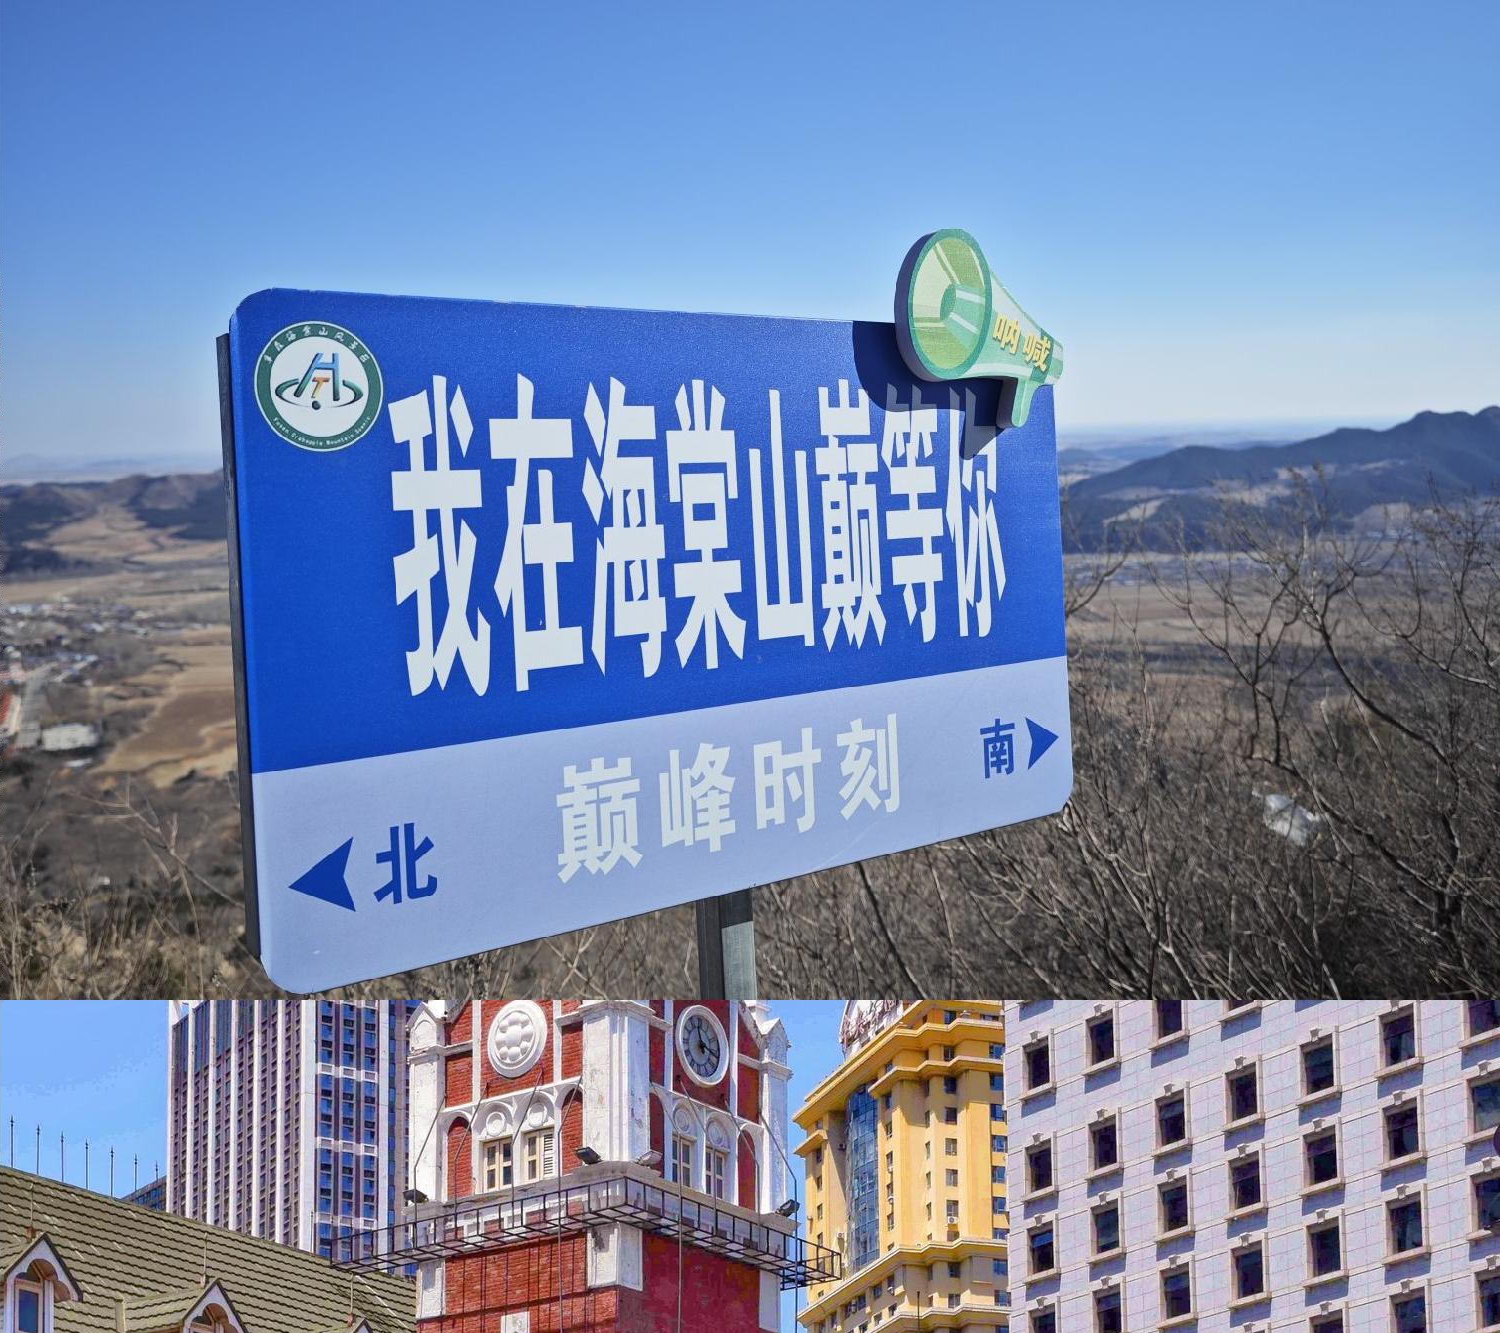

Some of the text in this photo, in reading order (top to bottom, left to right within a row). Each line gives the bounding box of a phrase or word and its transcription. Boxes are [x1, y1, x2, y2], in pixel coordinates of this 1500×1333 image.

[992, 313, 1052, 373] 呐喊
[389, 373, 1006, 698] 我在海棠山巅等你
[980, 718, 1016, 779] 南
[556, 713, 902, 883] 巅峰时刻
[374, 822, 438, 905] 北
